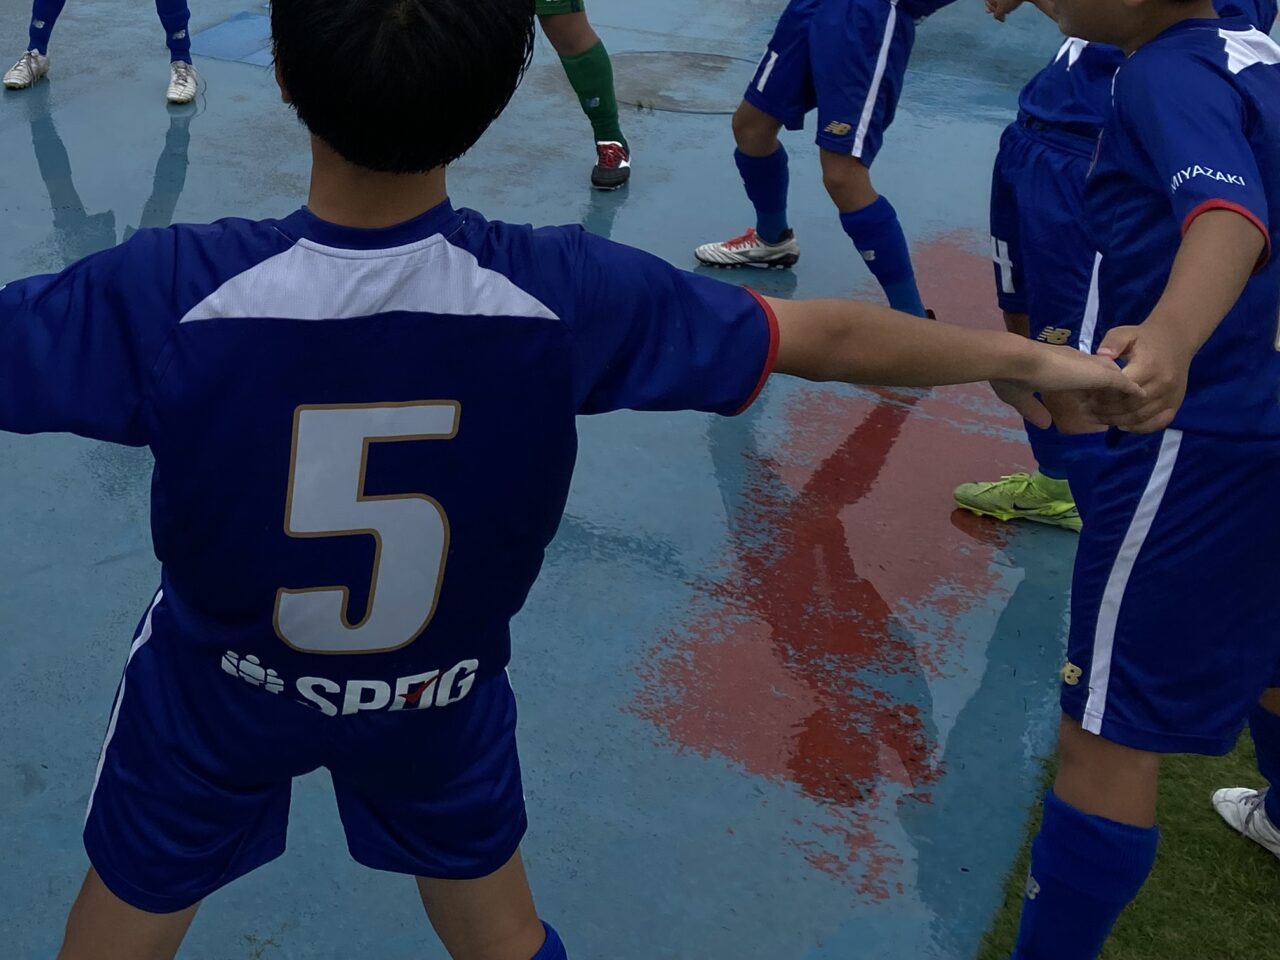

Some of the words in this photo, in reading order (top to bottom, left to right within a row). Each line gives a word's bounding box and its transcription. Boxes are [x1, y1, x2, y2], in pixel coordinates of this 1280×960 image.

[823, 120, 852, 136] NB
[1170, 164, 1246, 196] MIYAZAKI
[990, 235, 1017, 295] 4
[272, 399, 462, 655] 5
